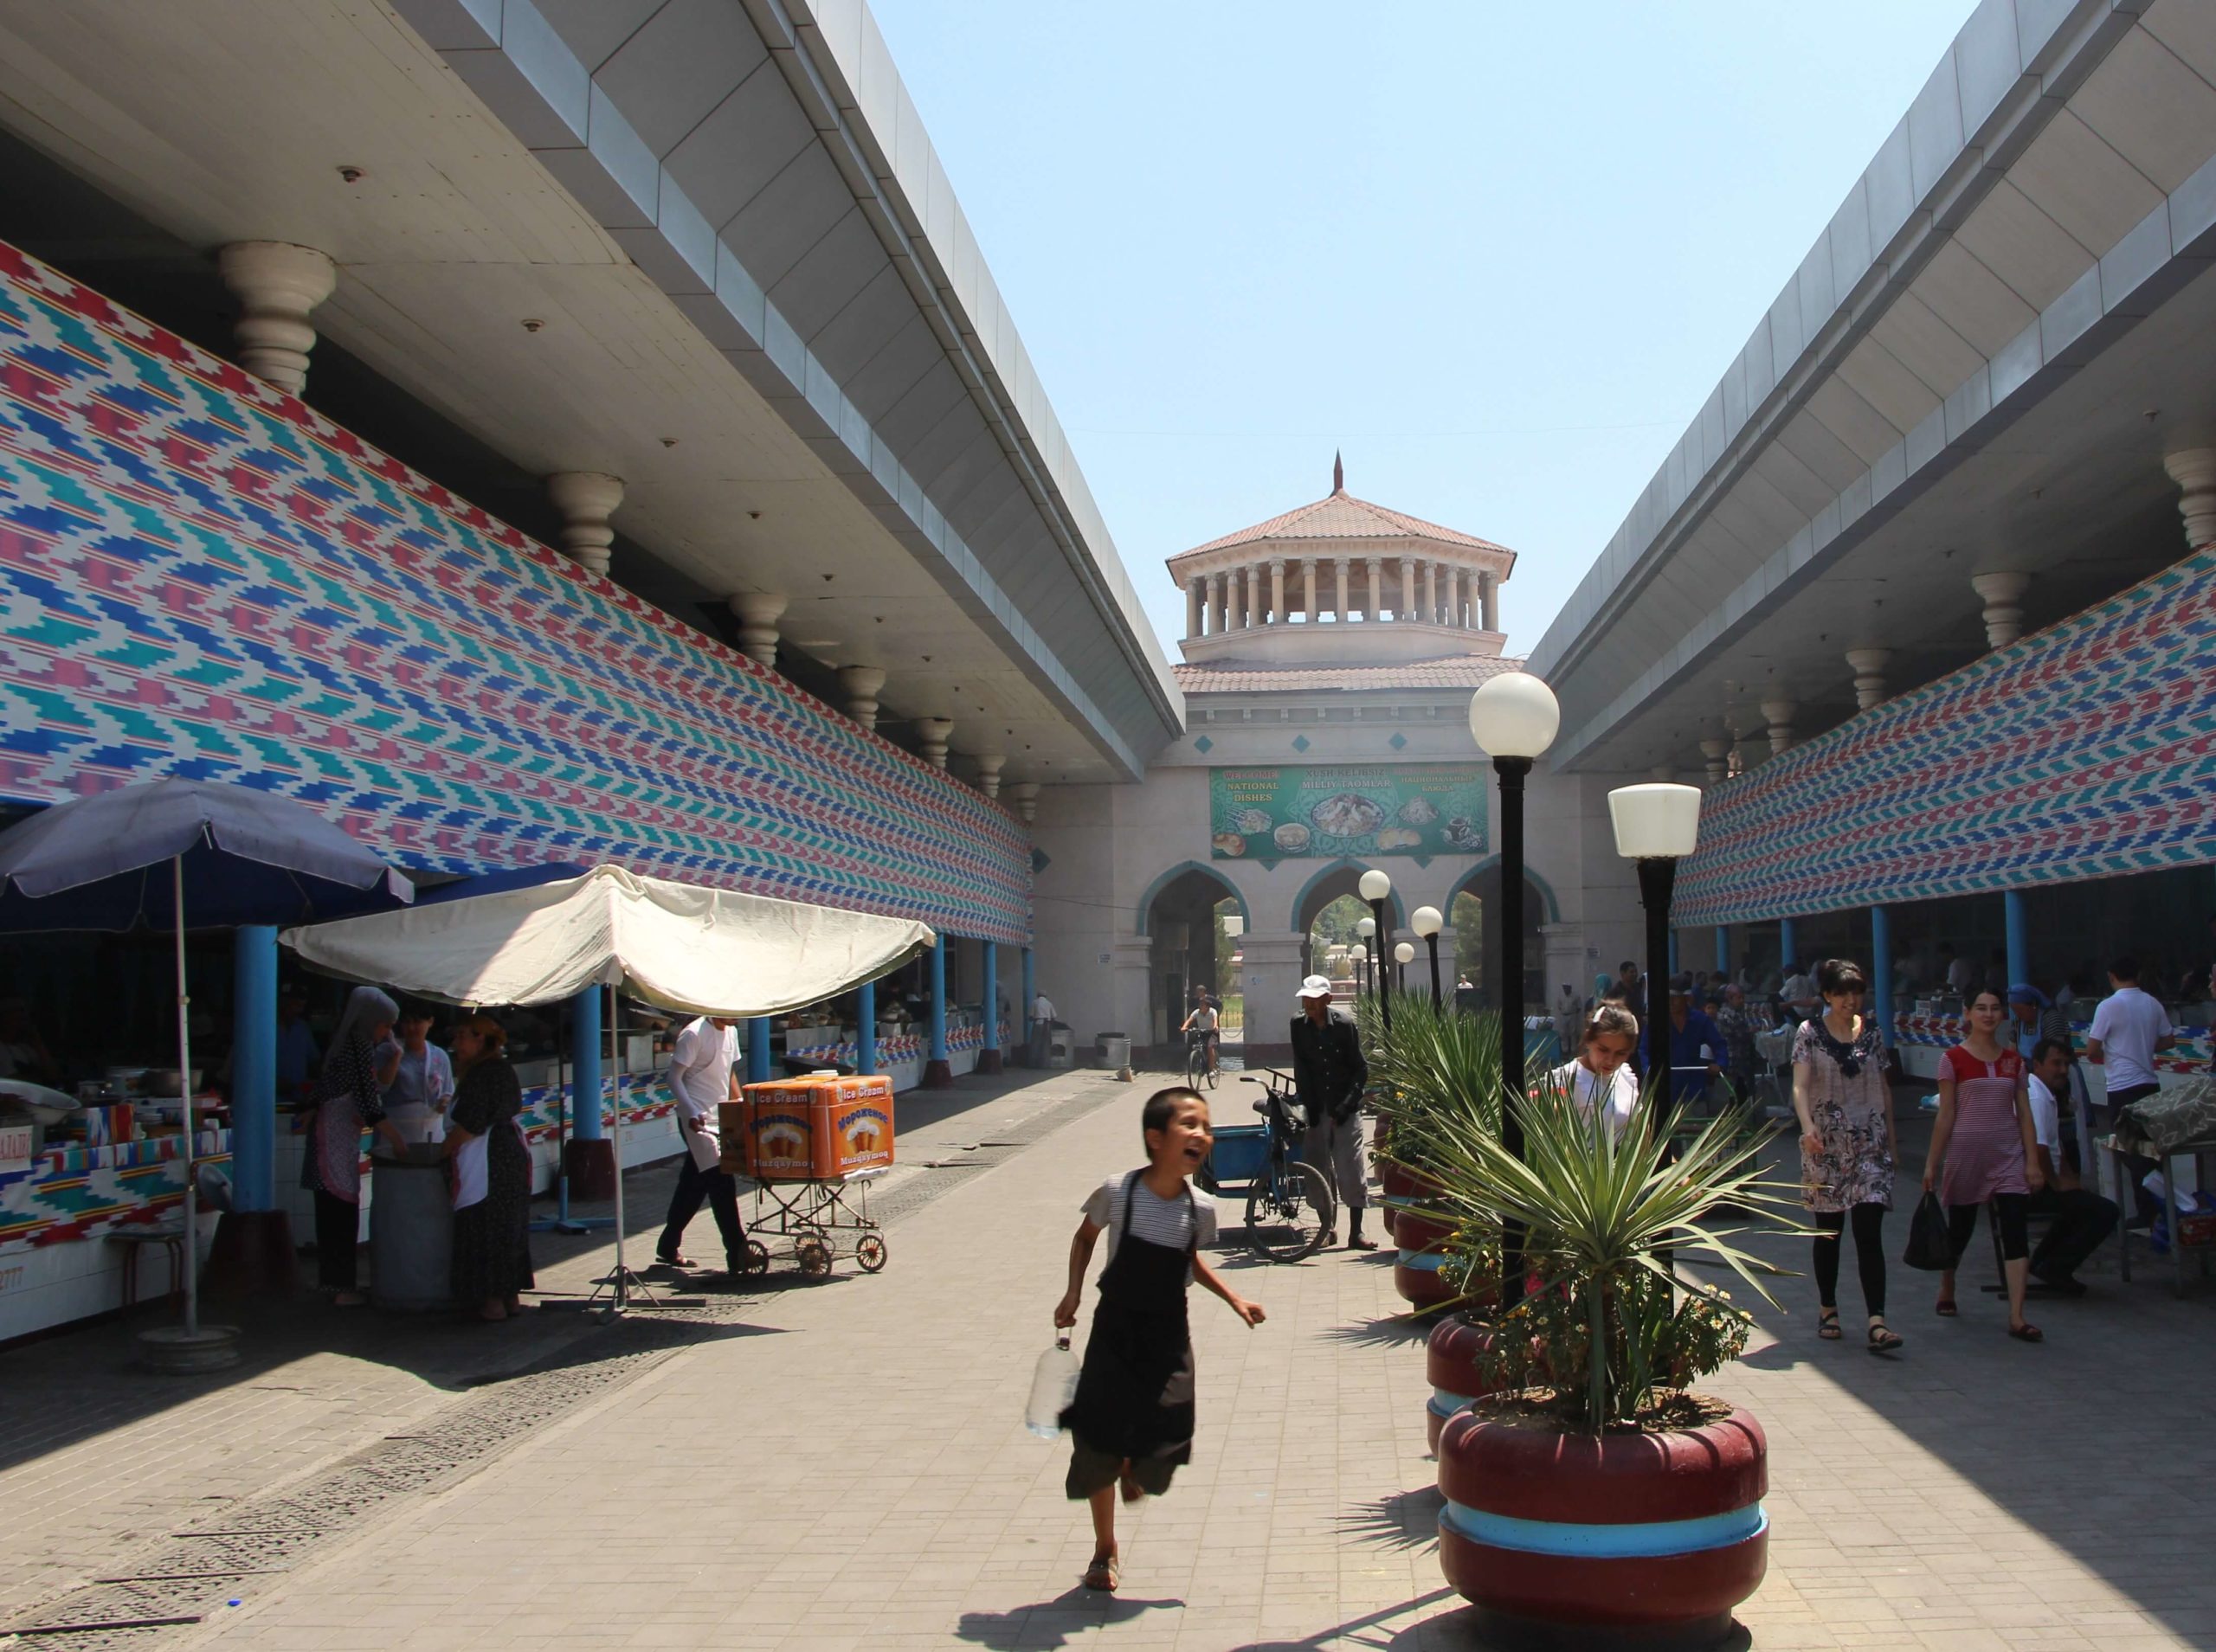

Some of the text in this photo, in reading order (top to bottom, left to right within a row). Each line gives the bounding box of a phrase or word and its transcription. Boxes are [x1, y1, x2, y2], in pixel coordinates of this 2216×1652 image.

[1227, 781, 1279, 790] NATIONAL
[1302, 780, 1392, 789] MILLIY TAOMLAR
[1234, 794, 1273, 802] DISHES
[756, 1092, 808, 1103] Ice Cream
[842, 1086, 884, 1100] Ice Cream
[838, 1108, 888, 1131] Мороженое
[840, 1150, 889, 1166] Muzqaymoq
